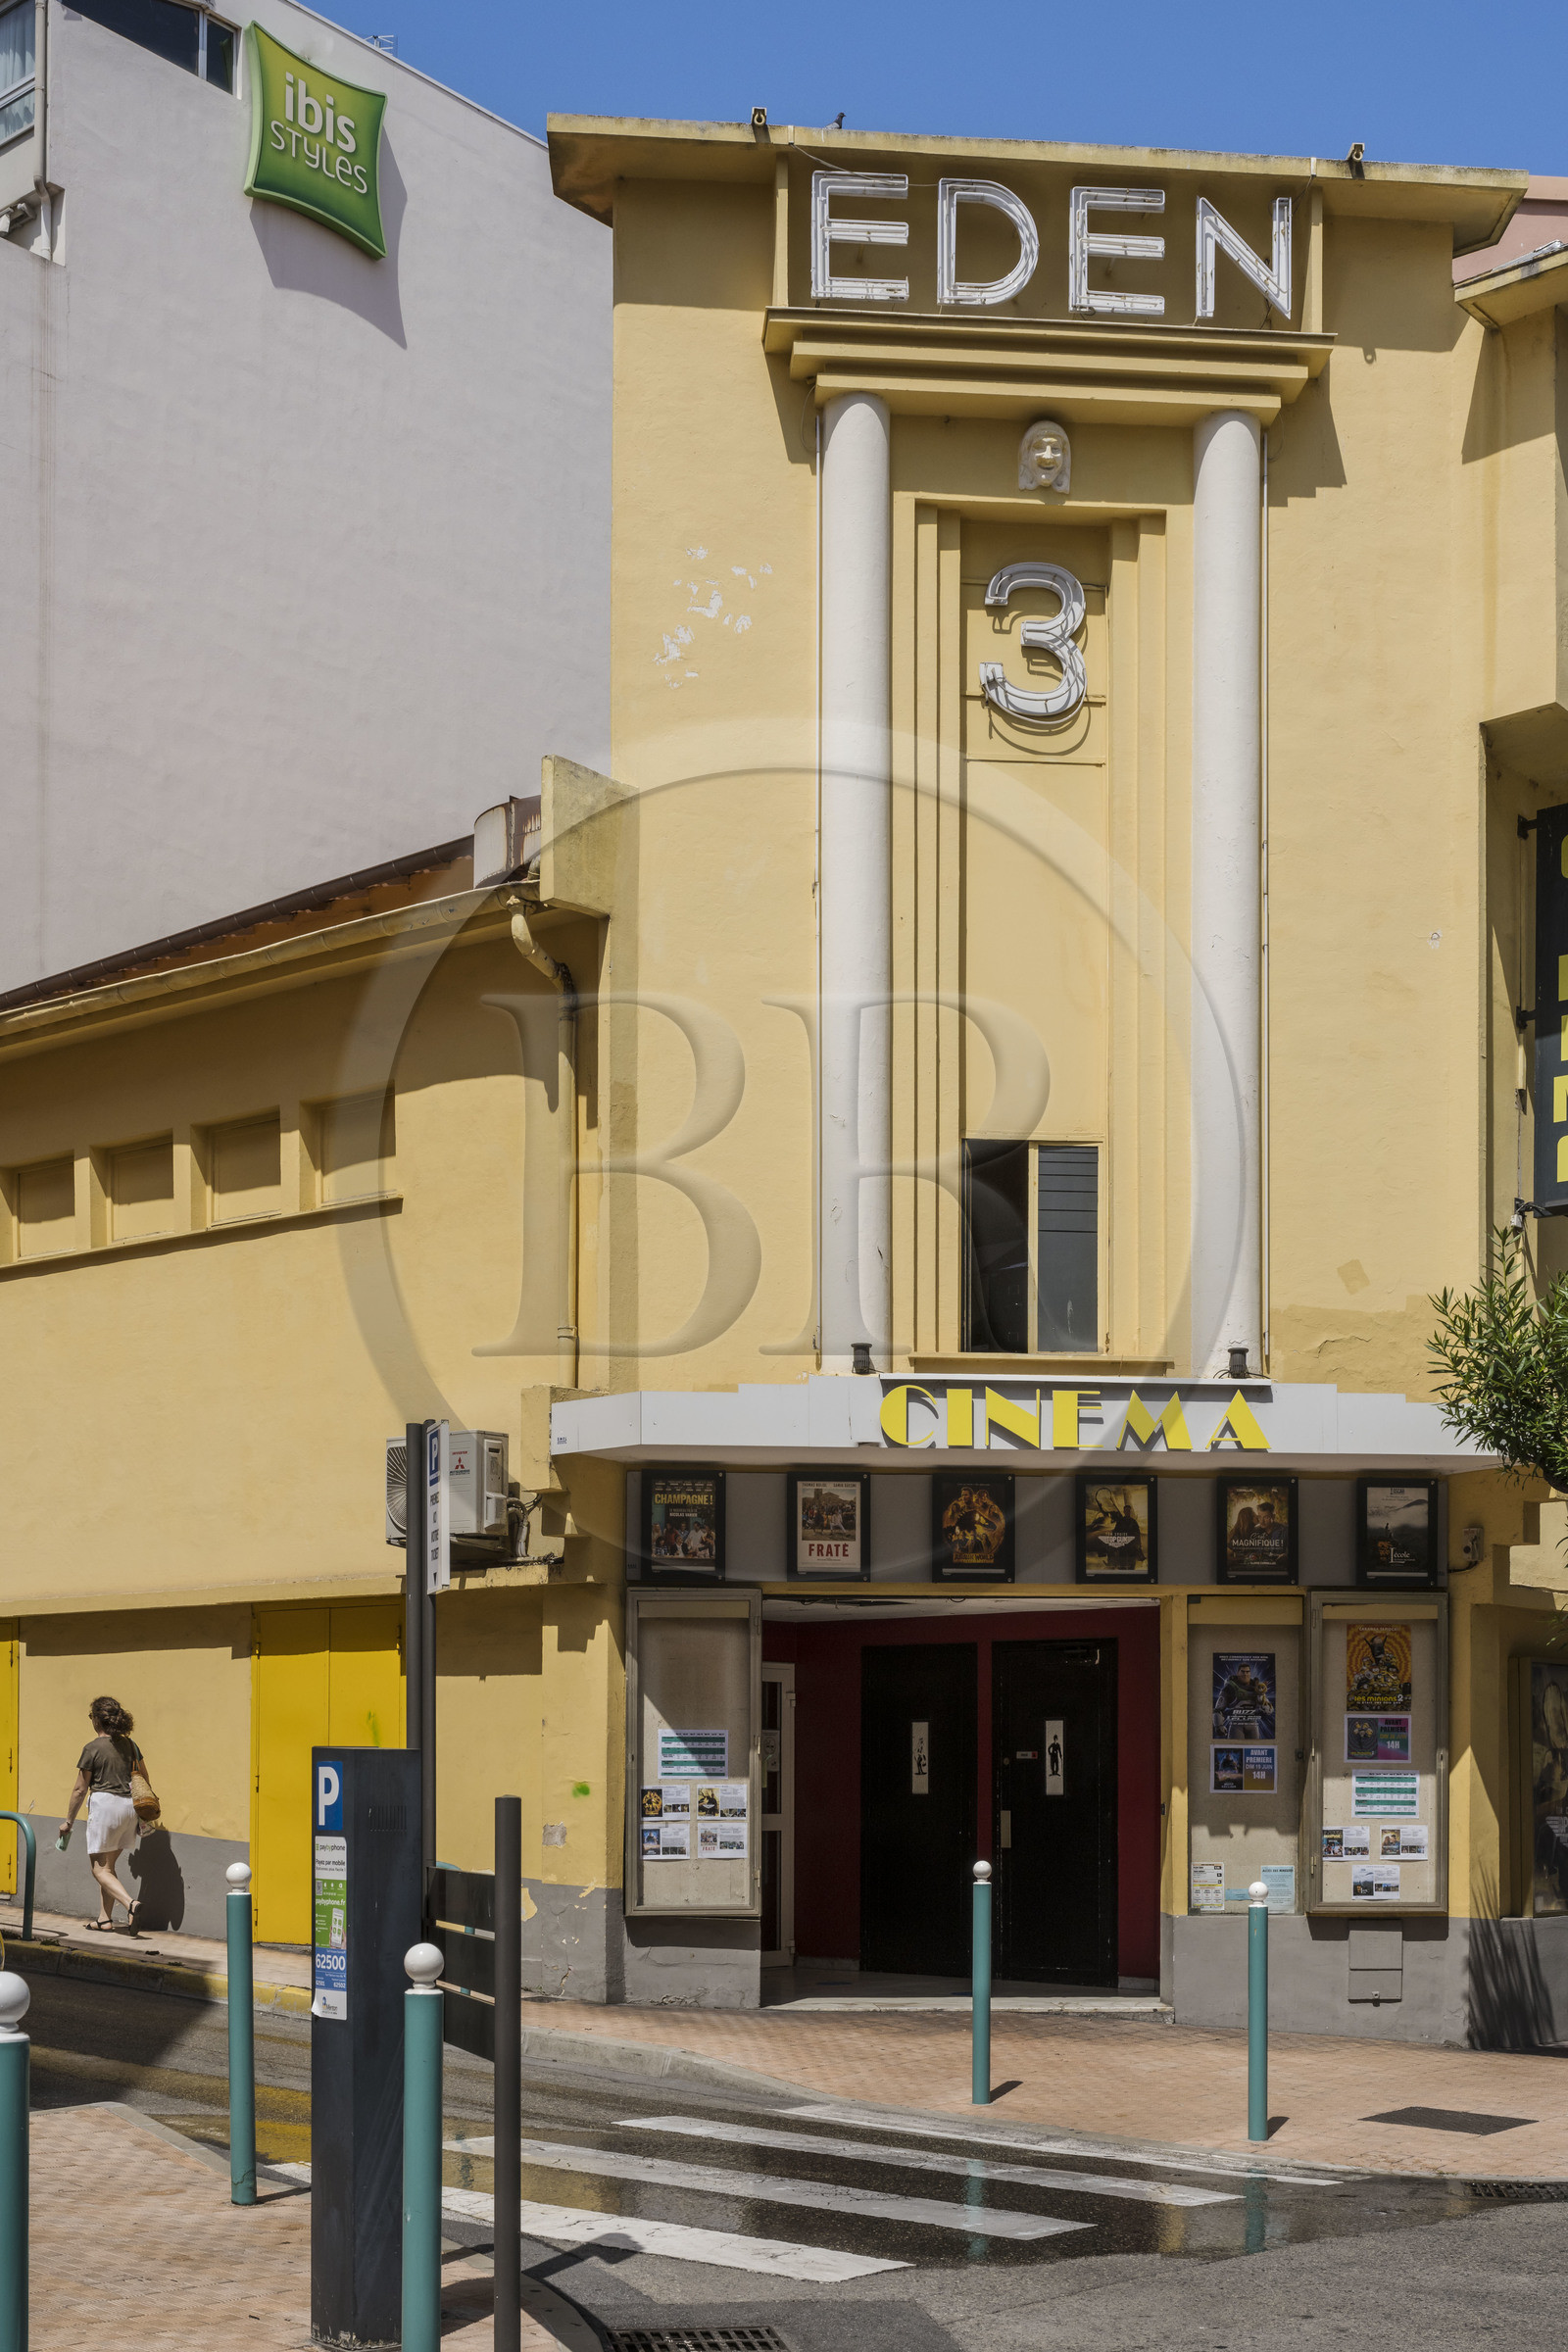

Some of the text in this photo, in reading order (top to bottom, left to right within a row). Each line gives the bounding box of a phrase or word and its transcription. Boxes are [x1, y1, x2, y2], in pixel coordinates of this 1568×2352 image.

[285, 71, 357, 154] ibis
[810, 170, 1293, 319] EDEN
[979, 562, 1088, 723] 3
[879, 1385, 1272, 1450] CINEMA
[432, 1437, 438, 1471] P
[1386, 1740, 1400, 1749] 14H
[318, 1766, 340, 1826] P
[1252, 1771, 1266, 1780] 14H
[316, 1953, 346, 1972] 62500
